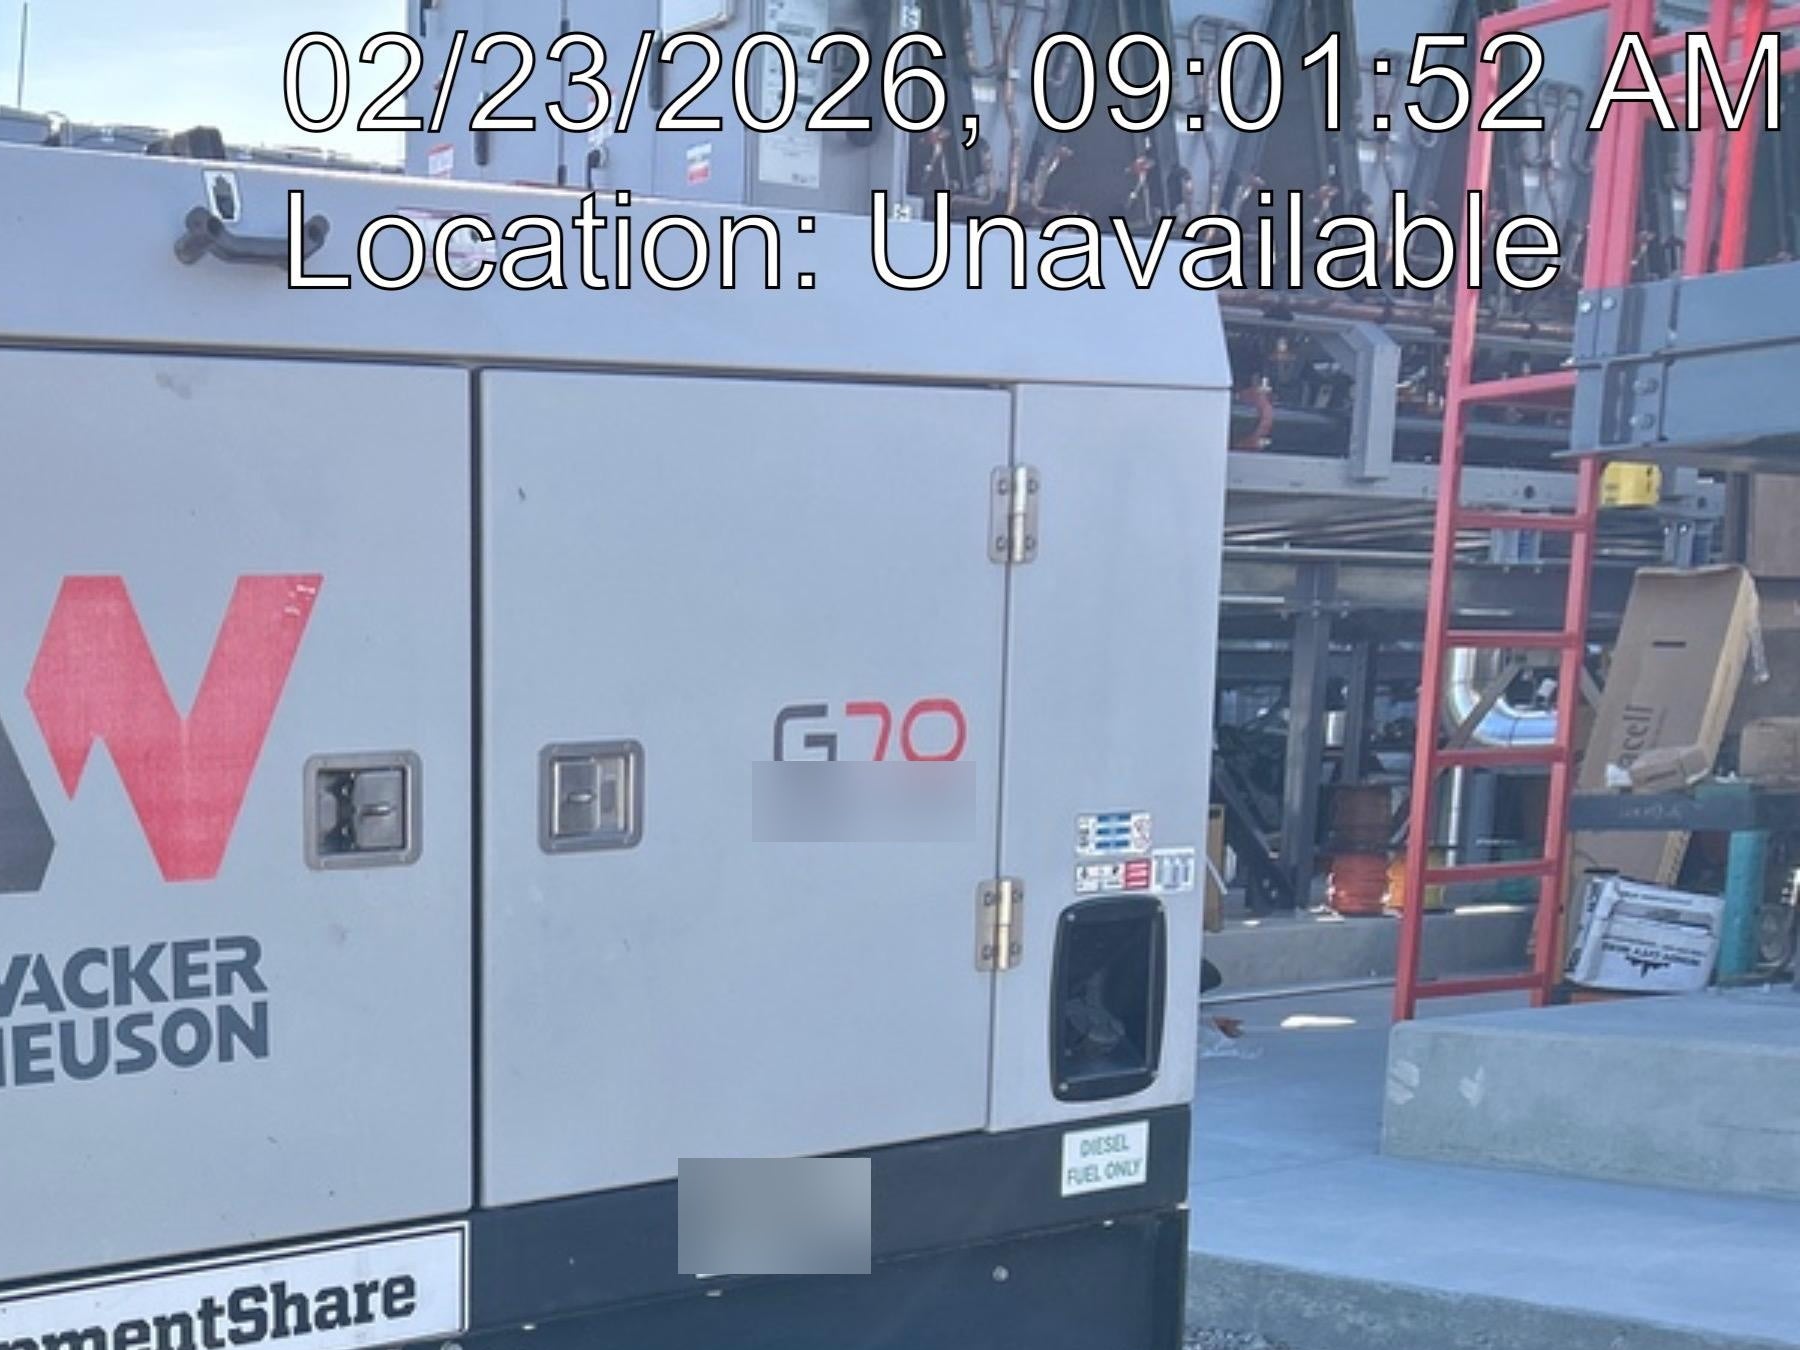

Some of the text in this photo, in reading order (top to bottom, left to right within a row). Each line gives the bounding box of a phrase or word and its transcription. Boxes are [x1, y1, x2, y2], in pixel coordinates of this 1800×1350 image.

[773, 698, 967, 761] G70
[1080, 1133, 1130, 1158] DIESEL
[1067, 1159, 1143, 1187] FUEL ONLY
